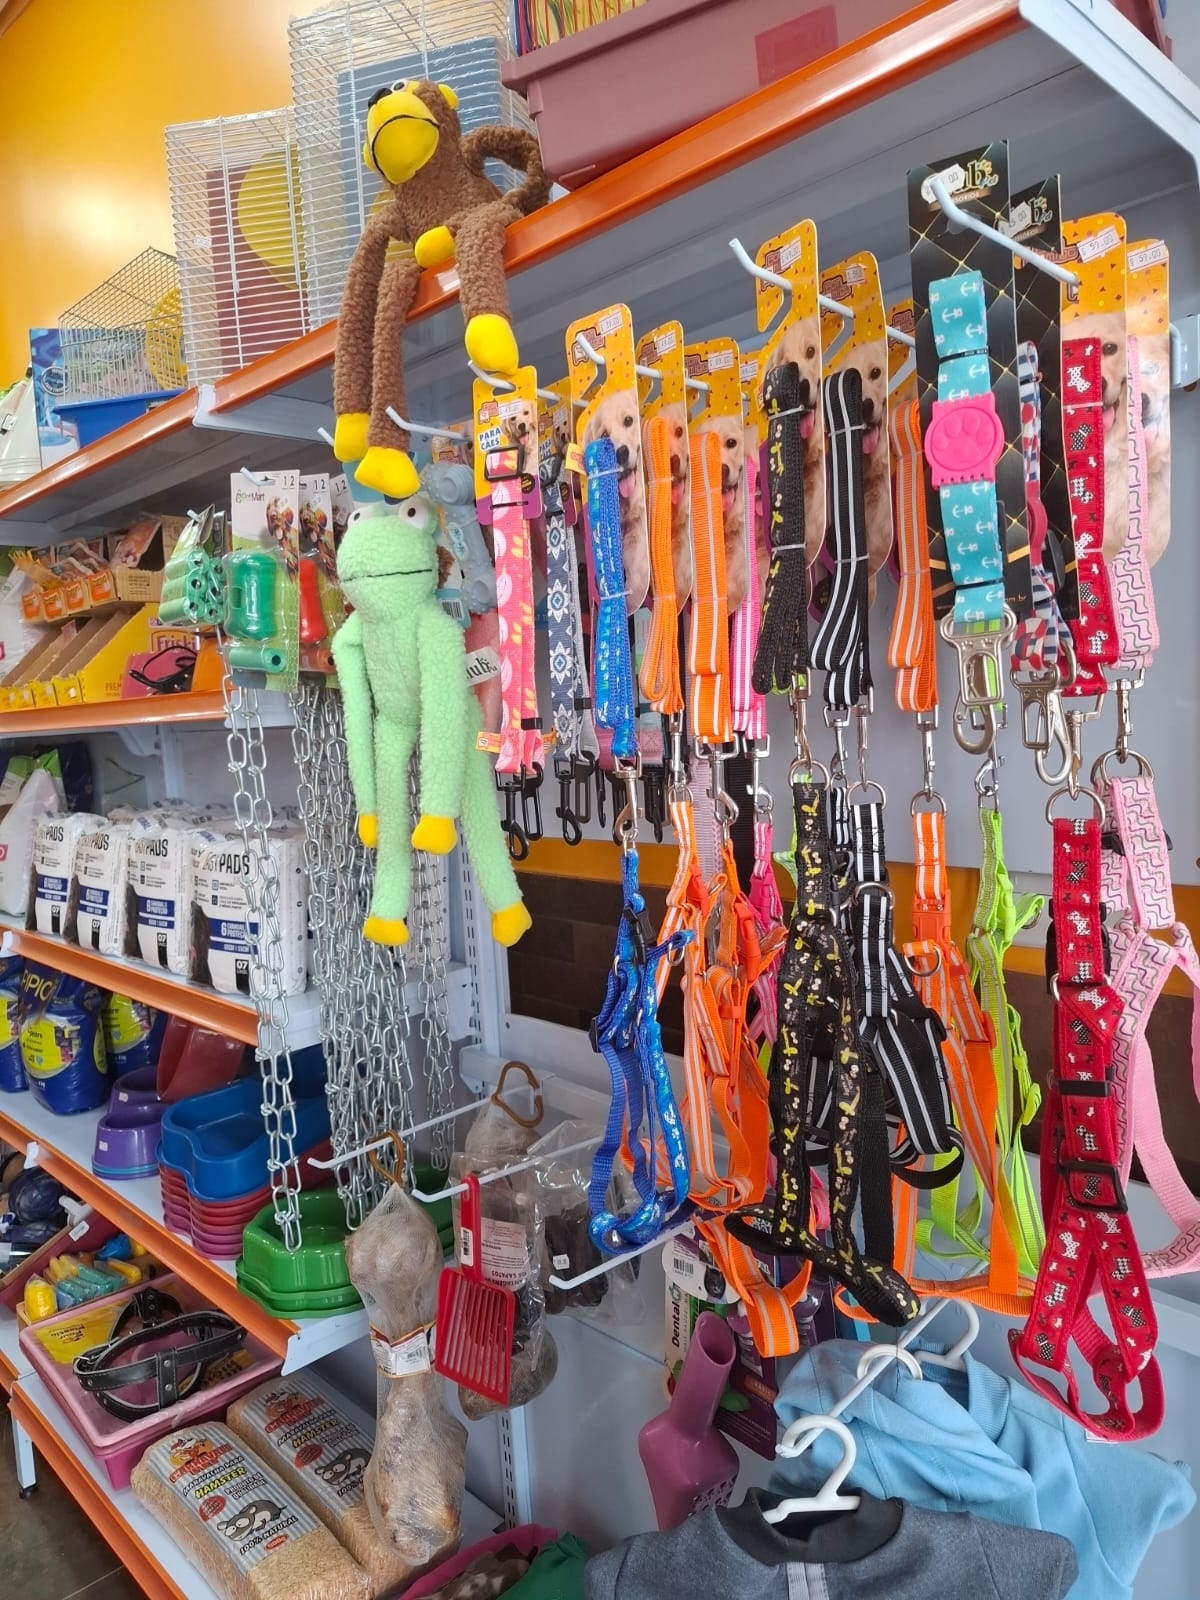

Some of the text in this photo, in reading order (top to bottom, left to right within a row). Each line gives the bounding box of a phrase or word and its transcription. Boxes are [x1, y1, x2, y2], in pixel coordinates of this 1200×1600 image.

[480, 427, 501, 441] PARA
[158, 934, 166, 942] 07
[221, 922, 227, 937] 6
[236, 960, 248, 969] 07
[671, 1301, 680, 1349] Dental
[291, 1418, 338, 1449] HAMSTER
[183, 1465, 225, 1496] MARAVALHA
[225, 1456, 245, 1470] PARA
[194, 1466, 247, 1499] HAMSTER
[224, 1476, 254, 1495] PRODUTO
[232, 1478, 266, 1500] QUALIDADE
[240, 1515, 299, 1556] 100% NATURAL
